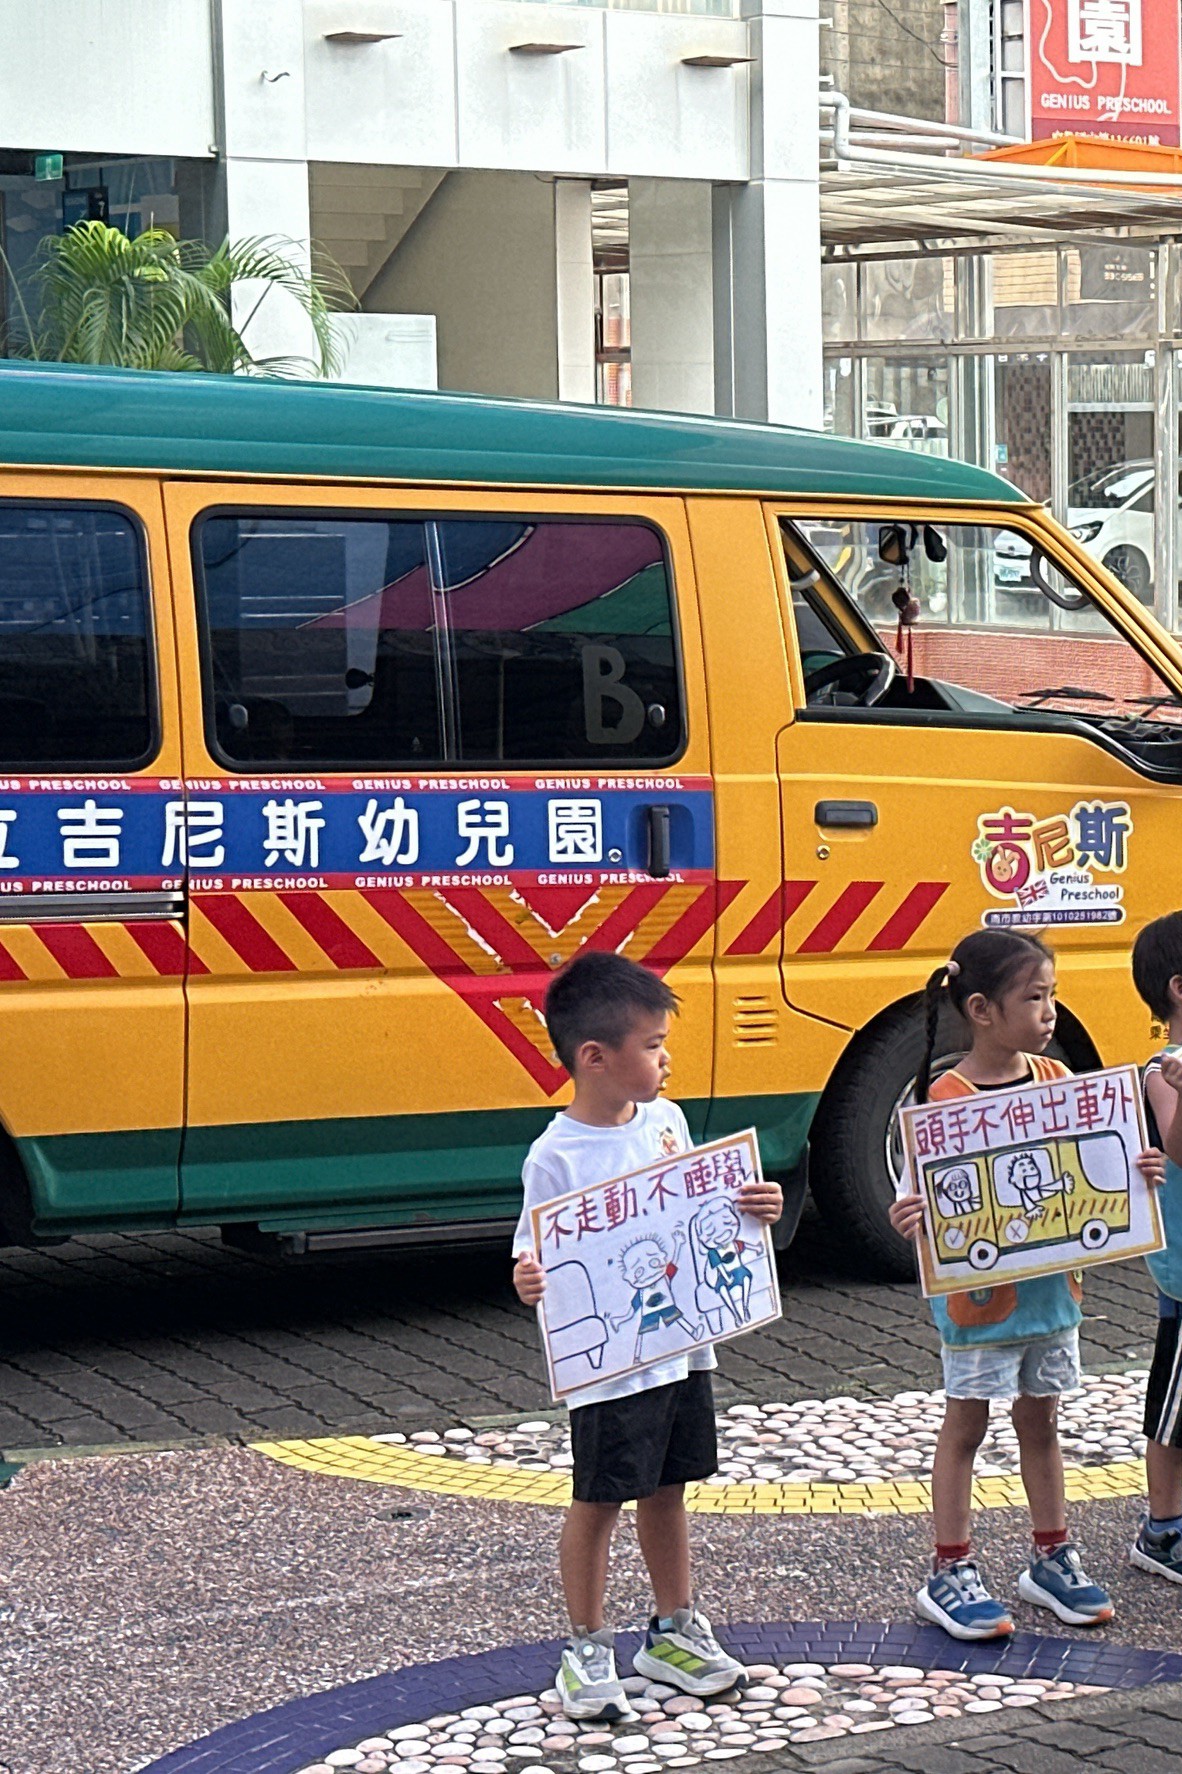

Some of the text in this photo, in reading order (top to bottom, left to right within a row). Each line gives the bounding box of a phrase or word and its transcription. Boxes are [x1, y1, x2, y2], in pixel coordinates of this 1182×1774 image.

[1068, 0, 1142, 66] 園
[1040, 93, 1172, 114] GENIUS PRESCHOOL
[581, 644, 645, 744] B
[29, 779, 131, 790] PRESCHOOL
[229, 779, 326, 790] PRESCHOOL
[352, 779, 412, 790] GENIUS
[419, 778, 510, 790] PRESCHOOL
[535, 778, 591, 789] GENIUS
[598, 778, 684, 789] PRESCHOOL
[982, 805, 1130, 895] 吉尼斯
[32, 880, 132, 891] PRESCHOOL
[231, 878, 328, 889] PRESCHOOL
[355, 876, 414, 888] GENIUS
[421, 875, 512, 887] PRESCHOOL
[538, 873, 593, 885] GENIUS
[1050, 871, 1089, 885] Genius
[1061, 887, 1119, 901] Preschool
[914, 1077, 1133, 1157] 頭手不伸出車外
